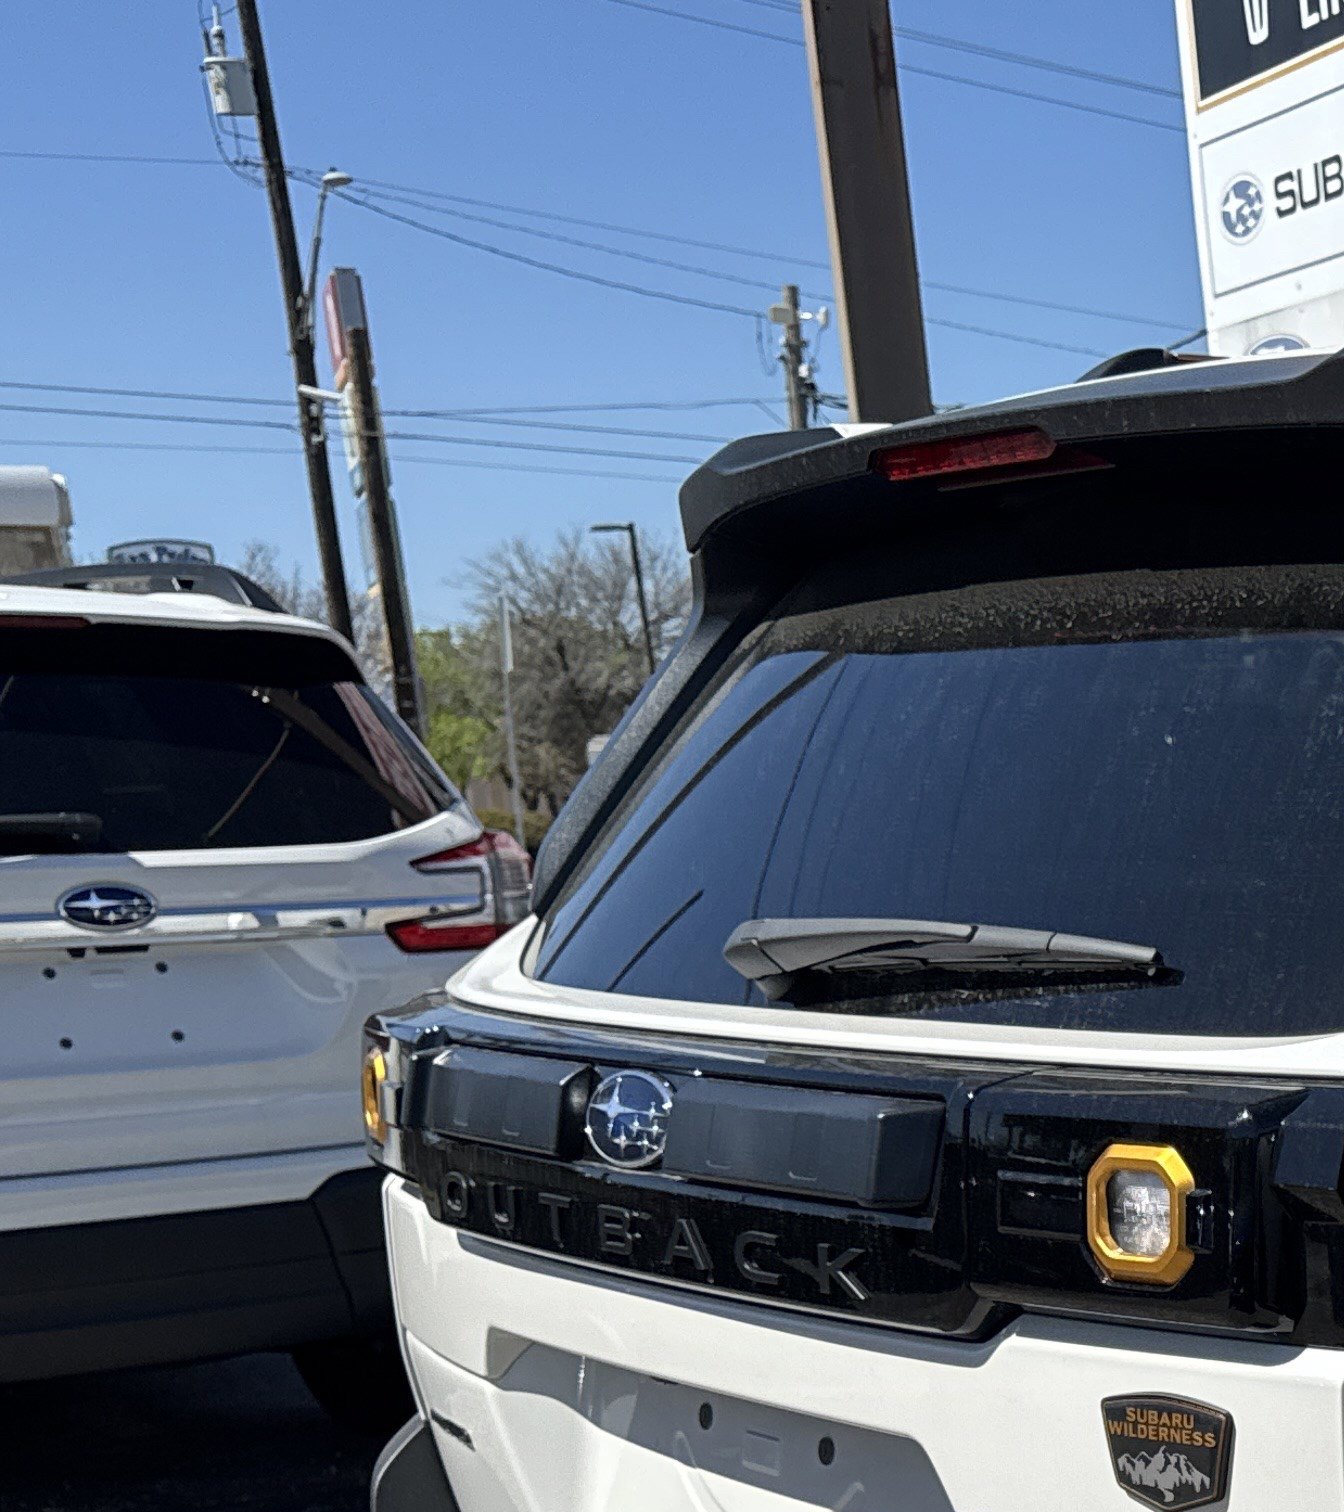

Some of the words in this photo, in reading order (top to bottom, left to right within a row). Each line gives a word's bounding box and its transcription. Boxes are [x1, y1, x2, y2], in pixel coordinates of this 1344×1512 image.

[440, 1170, 873, 1301] OUTBACK
[1126, 1407, 1195, 1430] SUBARU
[1108, 1420, 1217, 1448] WILDERNESS
